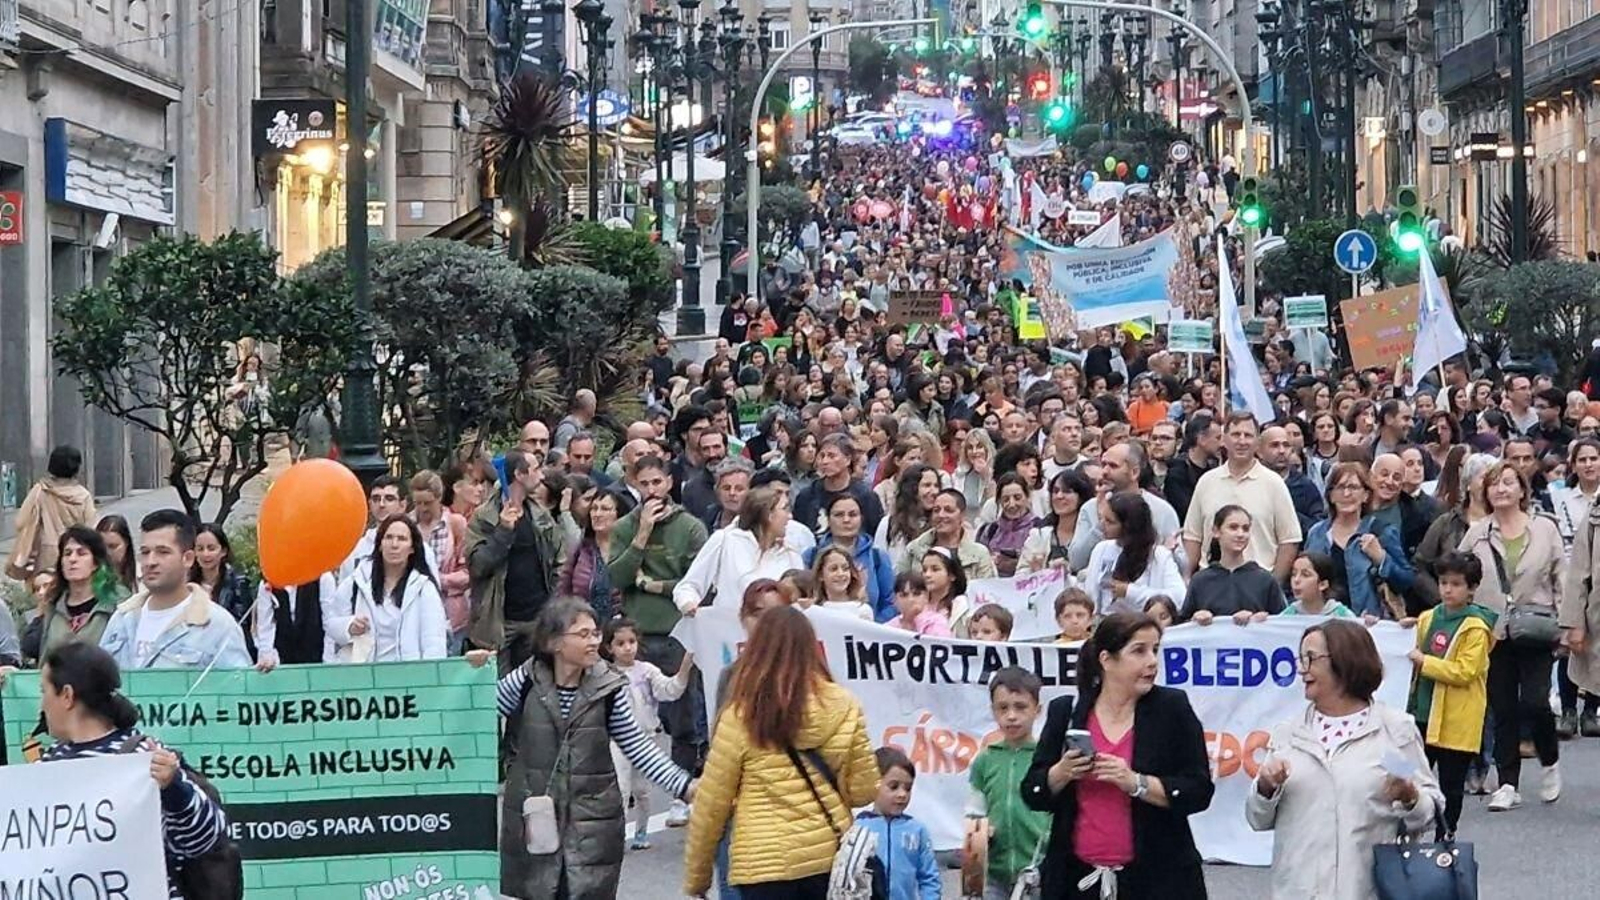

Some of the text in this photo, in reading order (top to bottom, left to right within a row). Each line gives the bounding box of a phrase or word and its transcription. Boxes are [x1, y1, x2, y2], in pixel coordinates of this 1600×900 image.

[1164, 646, 1297, 687] BLEDO
[137, 703, 207, 727] ANCIA
[238, 694, 419, 726] DIVERSIDADE
[202, 747, 456, 779] ESCOLA INCLUSIVA
[2, 798, 117, 851] ANPAS
[246, 821, 318, 841] TOD@S
[323, 816, 375, 836] PARA
[378, 812, 451, 833] TOD@S
[364, 875, 410, 900] NON
[414, 863, 443, 889] ÓS
